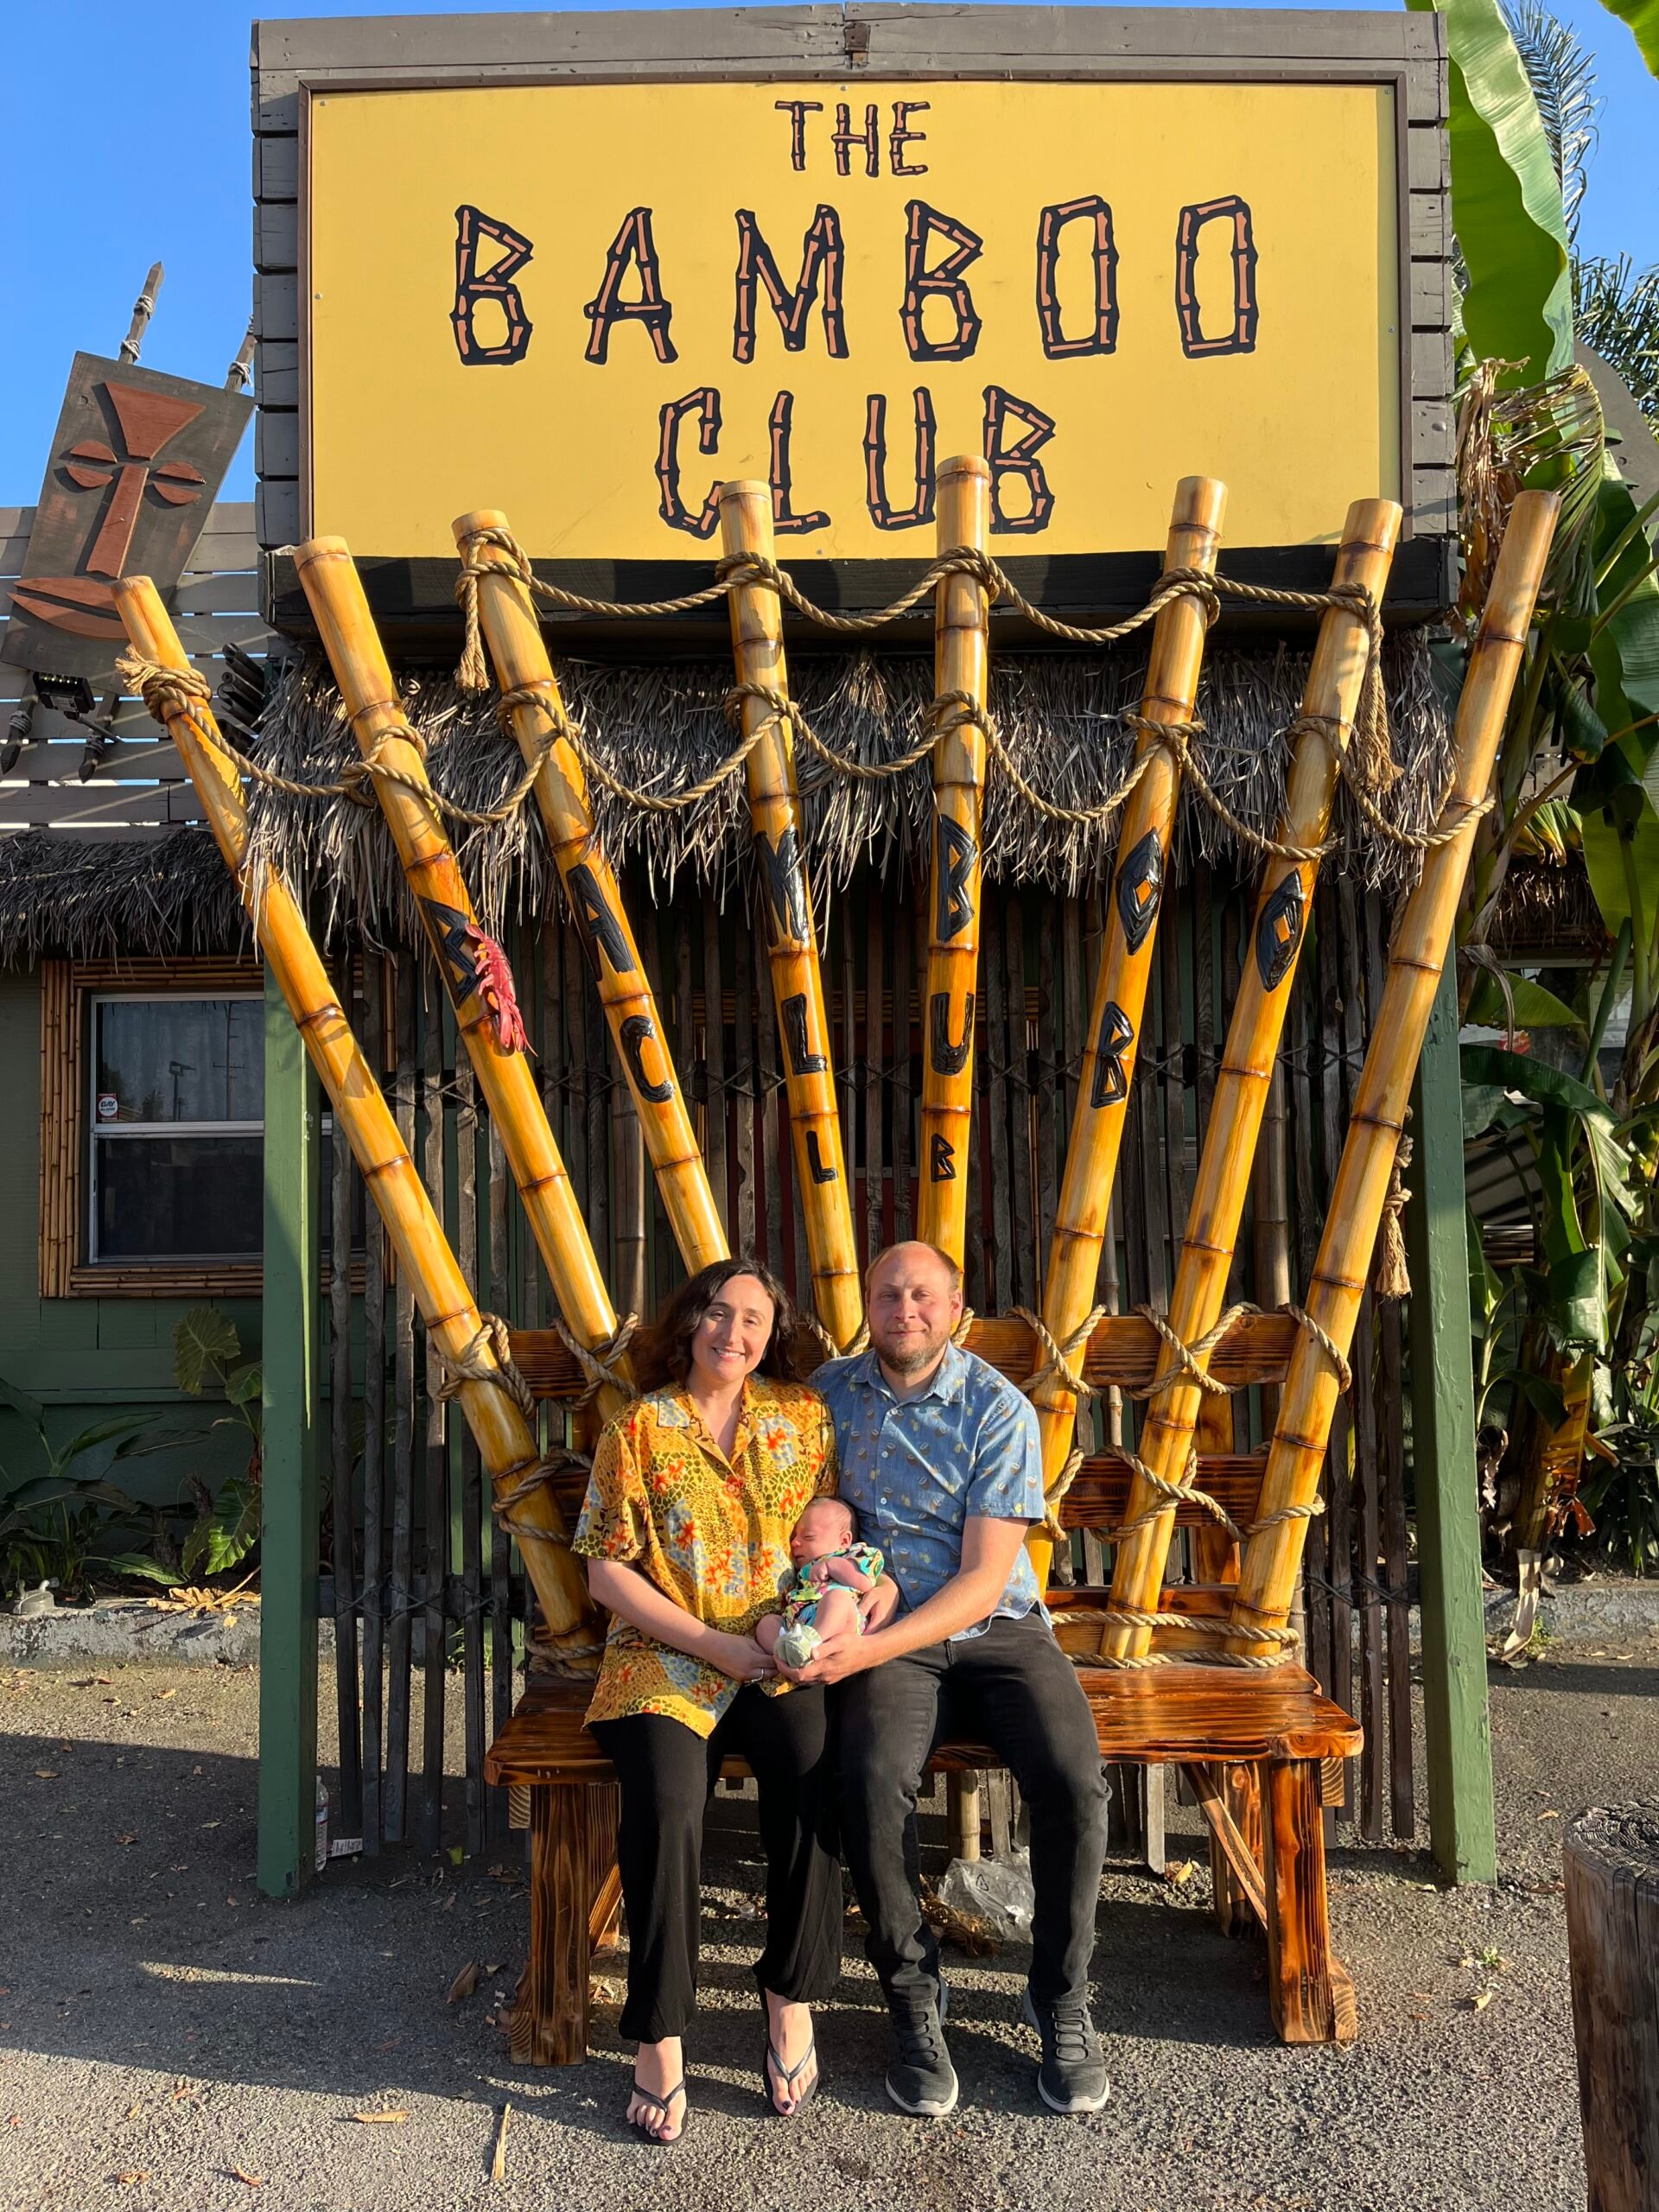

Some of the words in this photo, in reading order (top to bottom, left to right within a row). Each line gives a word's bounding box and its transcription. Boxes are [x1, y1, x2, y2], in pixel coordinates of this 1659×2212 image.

[774, 99, 931, 177] THE
[451, 195, 1259, 366] BAMBOO
[655, 385, 1056, 540] CLUB
